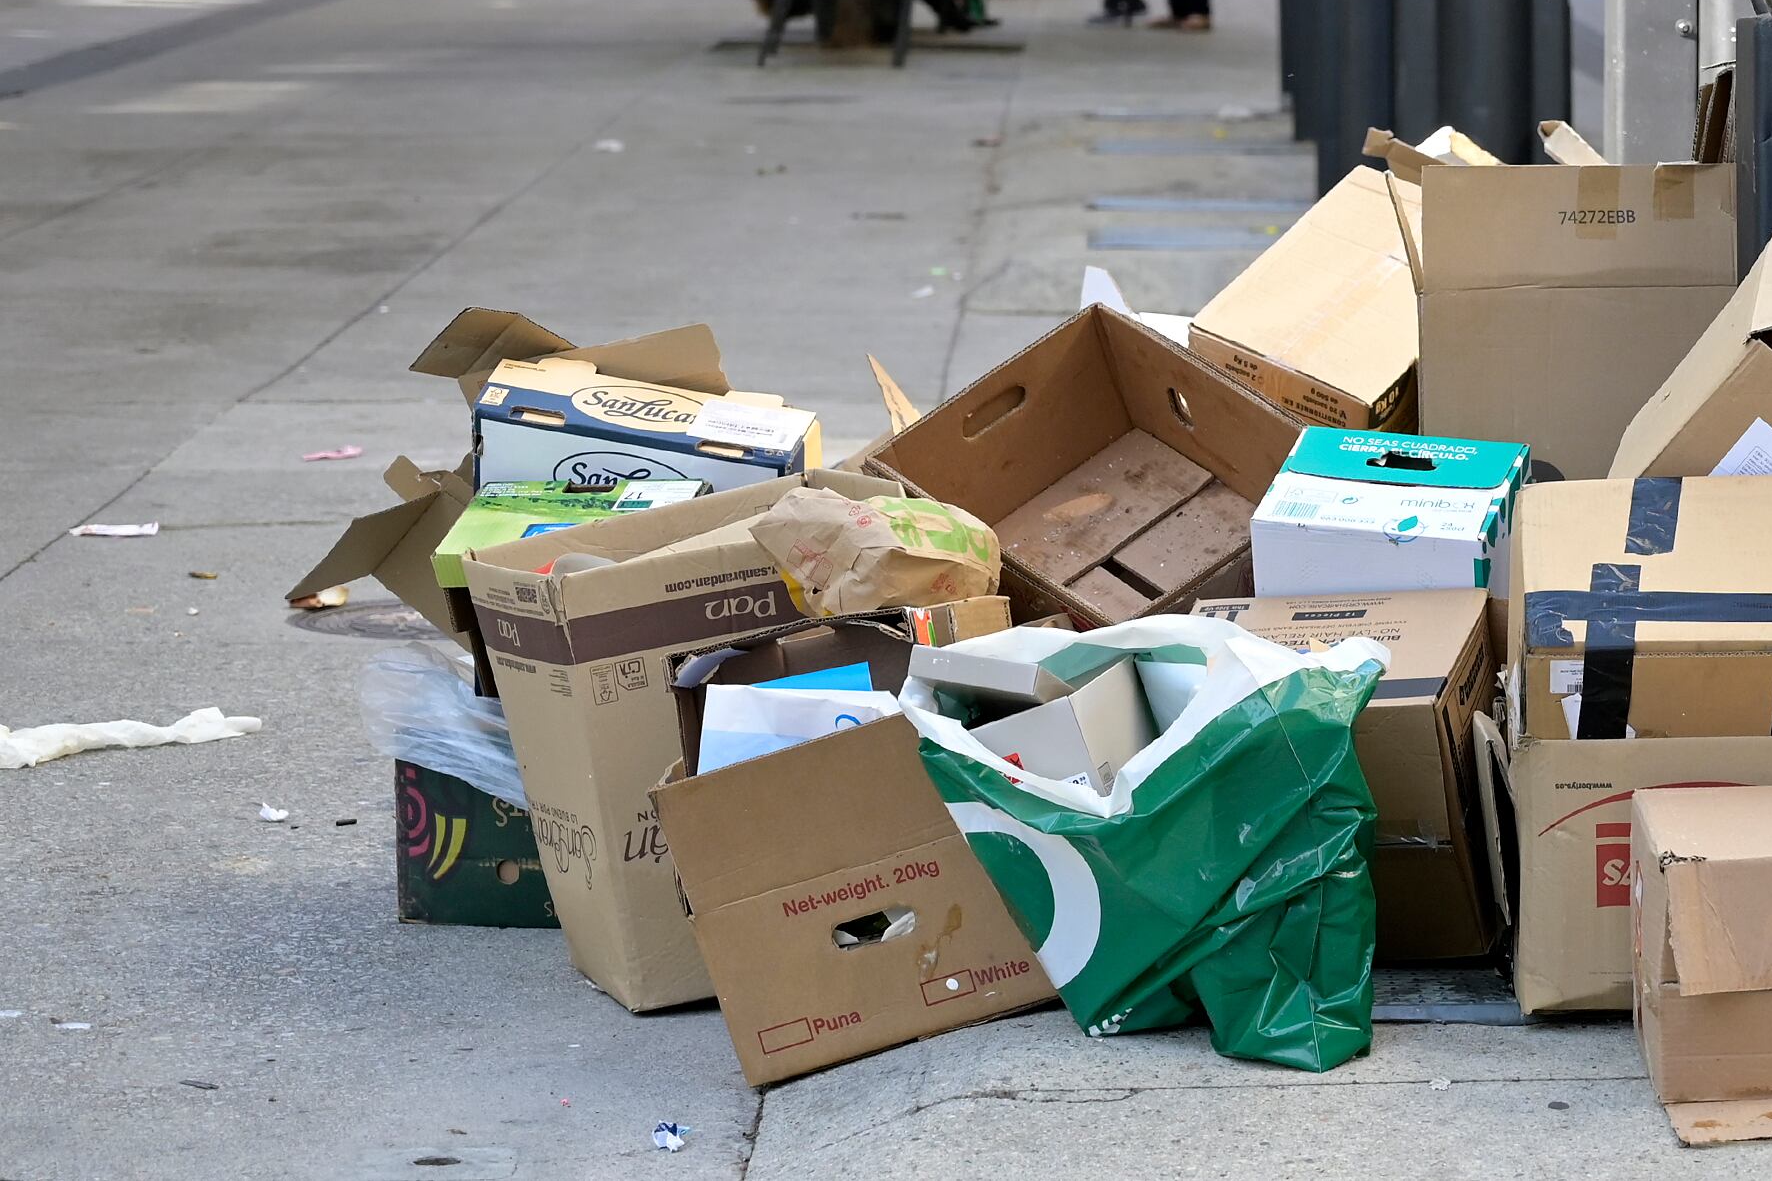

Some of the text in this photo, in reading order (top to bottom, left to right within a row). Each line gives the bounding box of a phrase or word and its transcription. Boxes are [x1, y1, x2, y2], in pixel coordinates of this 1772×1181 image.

[1558, 209, 1637, 226] 74272EBB
[1338, 443, 1387, 455] CIERRA
[1342, 436, 1364, 446] NO
[1367, 438, 1400, 448] SEAS
[782, 860, 940, 918] Net-weight. 20kg
[975, 959, 1030, 985] White
[813, 1011, 862, 1035] Puna
